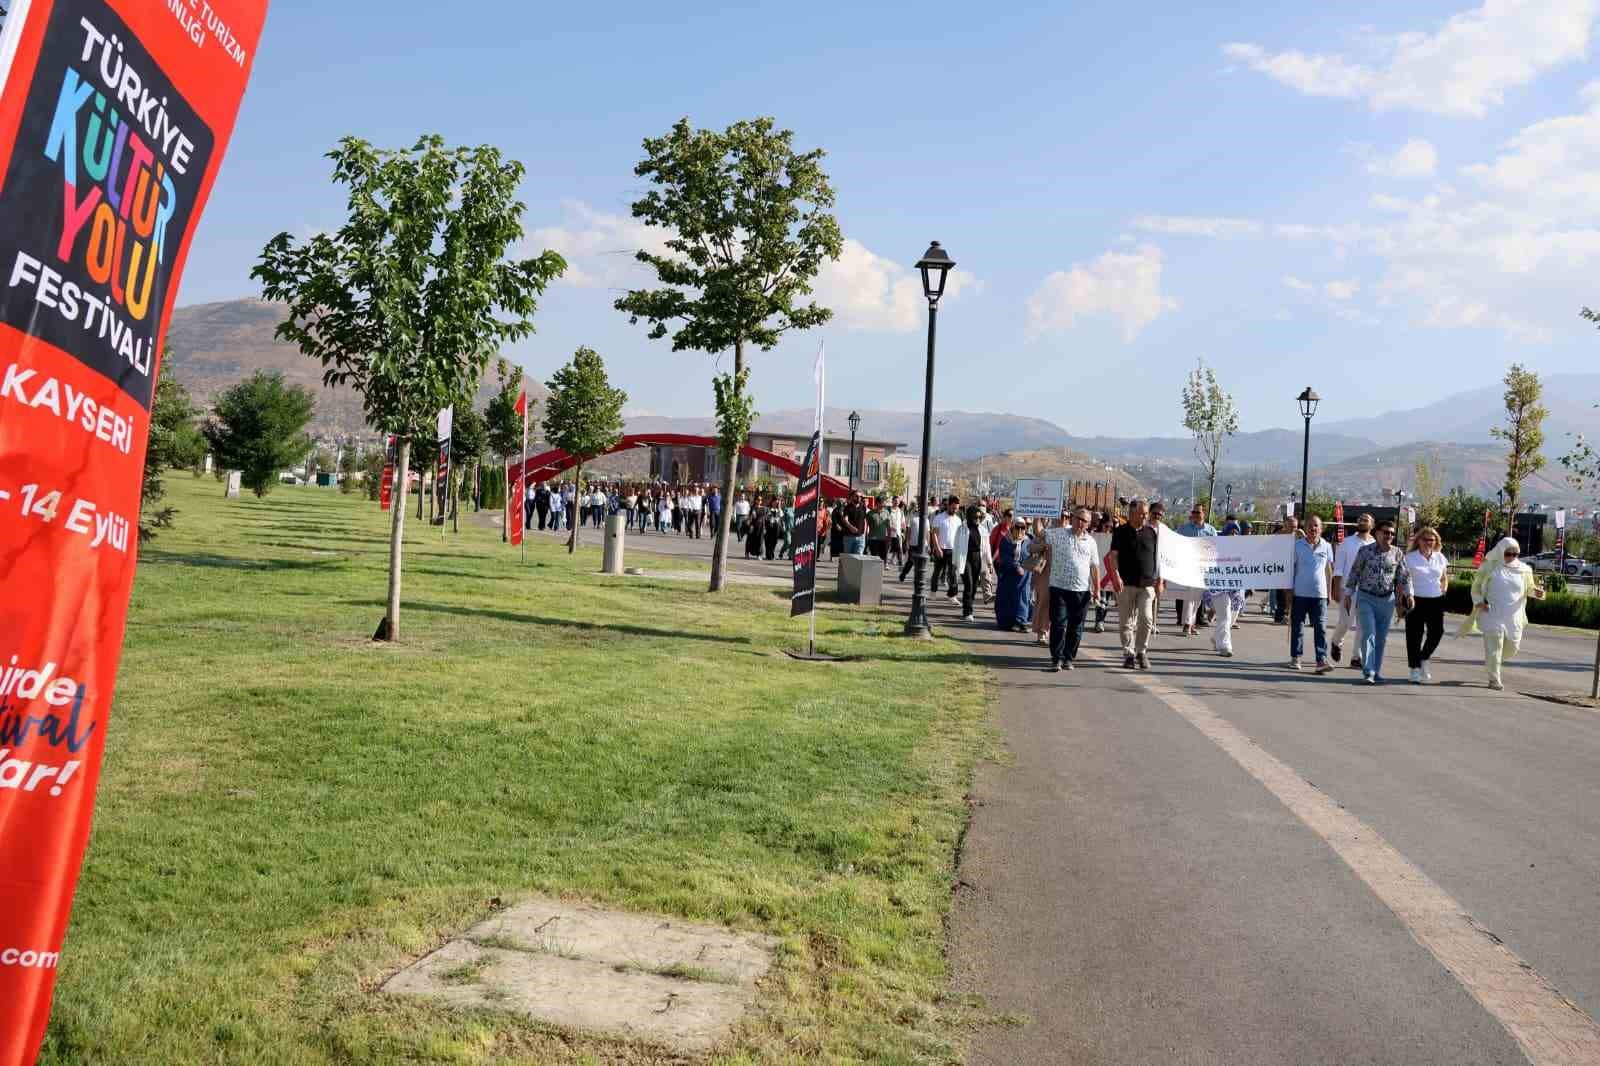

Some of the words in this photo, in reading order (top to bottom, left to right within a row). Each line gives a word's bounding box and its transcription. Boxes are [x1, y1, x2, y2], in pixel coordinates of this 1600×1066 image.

[201, 0, 247, 68] TURİZM
[79, 16, 194, 175] TÜRKİYE
[44, 66, 177, 264] KÜLTÜR
[57, 180, 160, 320] YOLU
[8, 250, 153, 377] FESTİVALİ
[0, 363, 134, 455] KAYSERİ
[20, 484, 62, 523] 14
[64, 498, 129, 553] Eylül
[1225, 563, 1260, 575] SAĞLIK
[1263, 562, 1285, 576] İÇİN
[0, 655, 78, 706] irde
[0, 748, 81, 797] ar!
